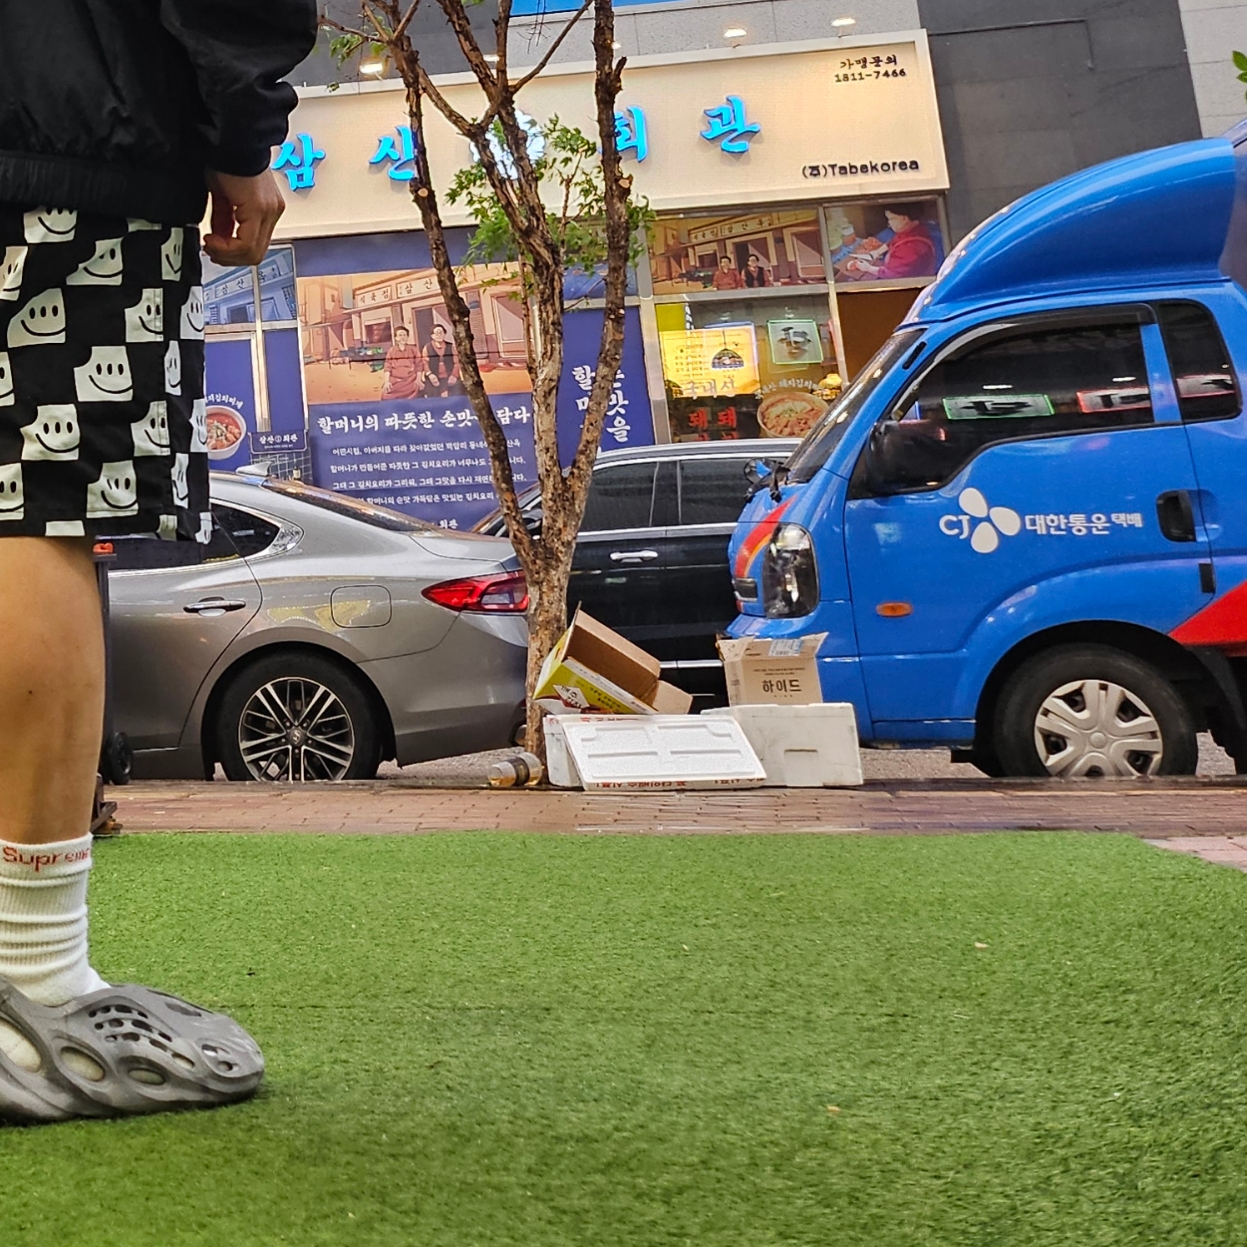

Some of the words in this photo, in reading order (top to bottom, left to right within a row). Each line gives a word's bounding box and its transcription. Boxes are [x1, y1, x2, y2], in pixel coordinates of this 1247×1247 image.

[834, 68, 907, 83] 1811-7466
[317, 414, 380, 435] 할머니의
[384, 412, 435, 431] 따뜻한
[496, 406, 531, 426] 담다
[938, 514, 971, 540] CJ
[1024, 513, 1112, 536] 대한통운
[1111, 512, 1144, 528] 택배
[762, 678, 803, 694] 하이드
